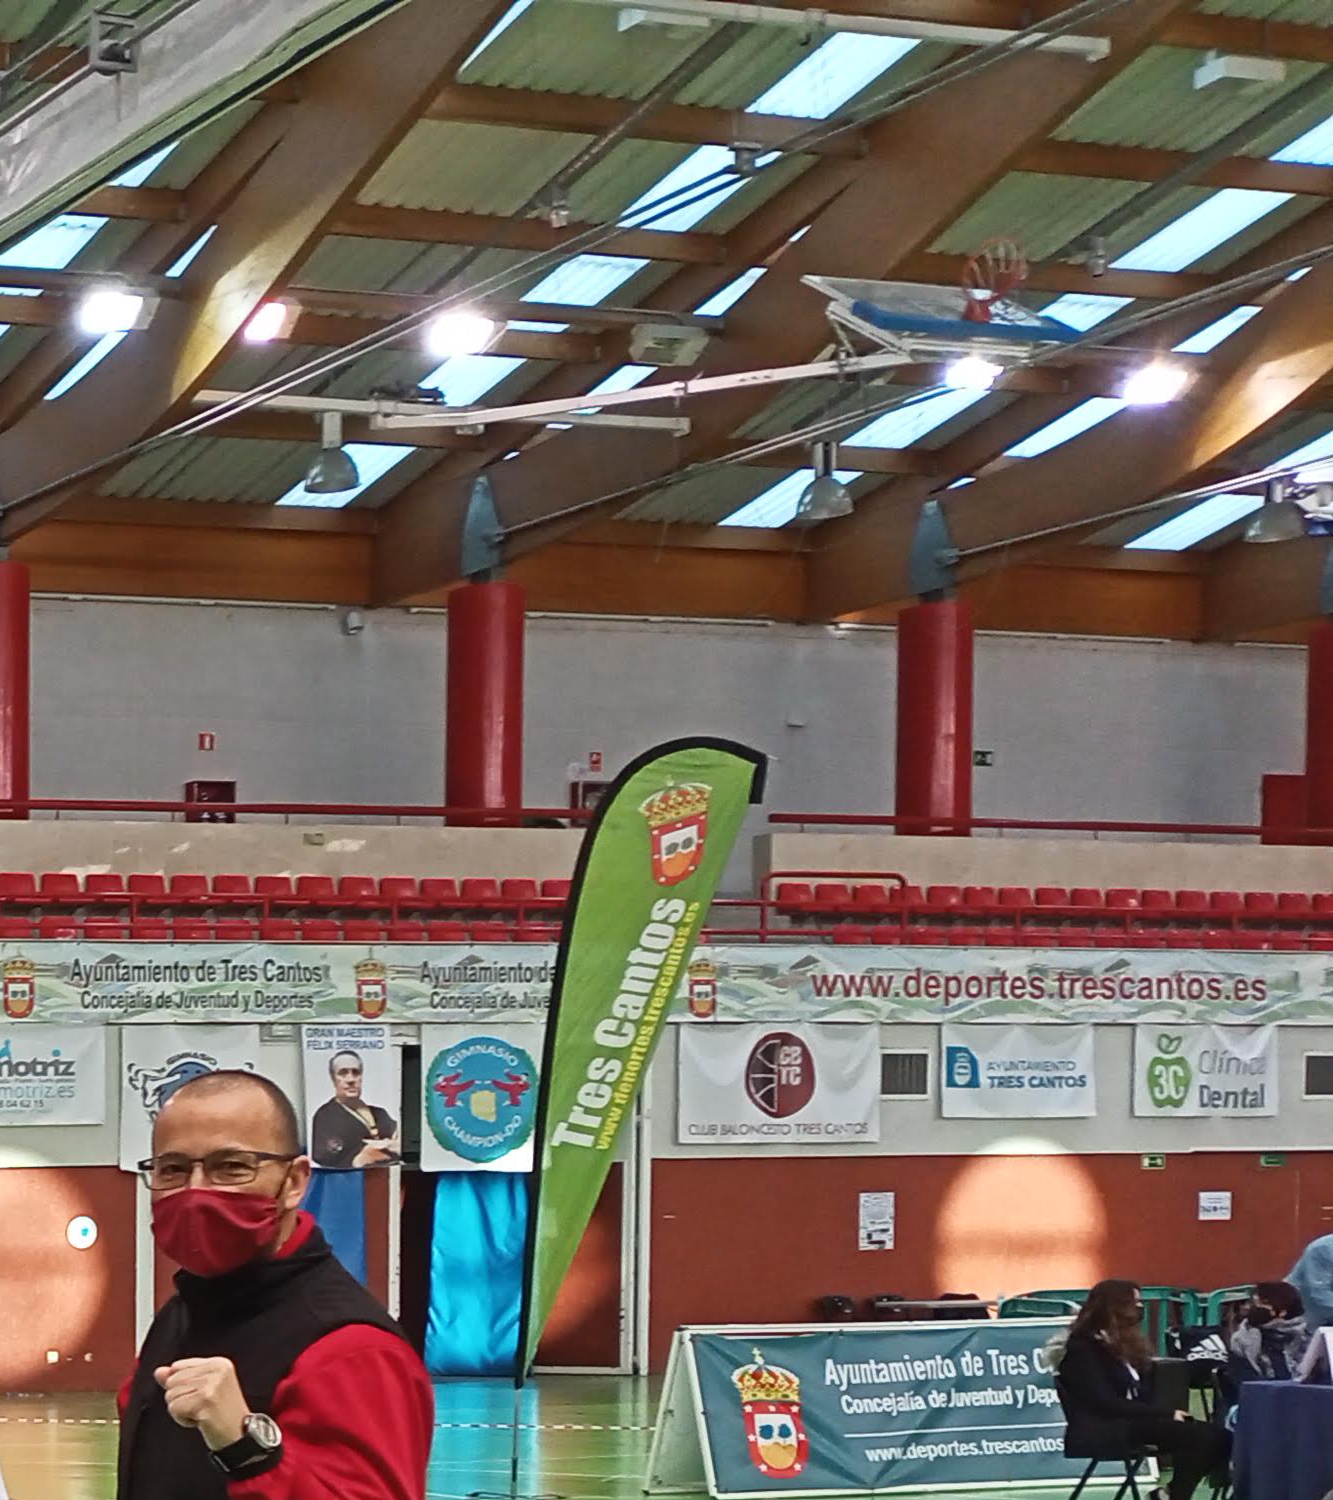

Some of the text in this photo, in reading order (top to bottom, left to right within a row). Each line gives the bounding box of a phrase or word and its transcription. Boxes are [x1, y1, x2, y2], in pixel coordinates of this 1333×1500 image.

[70, 958, 323, 988] Ayuntamiento de Tres Cantos
[419, 962, 532, 988] Ayuntamiento
[812, 967, 1267, 1007] www.deportes.trescantos.es
[155, 991, 173, 1009] de
[174, 990, 239, 1010] Juventud
[242, 996, 251, 1013] y
[253, 989, 314, 1011] Deportes
[500, 991, 516, 1009] de
[518, 990, 550, 1010] Juve
[306, 1027, 384, 1038] GRAN MAESTRO
[551, 898, 686, 1148] Tres Cantos
[336, 1039, 384, 1050] SERRANO
[446, 1044, 518, 1067] GIMNASIO
[987, 1060, 1076, 1072] AYUNTAMIENTO
[1198, 1049, 1267, 1076] Clínica
[779, 1066, 803, 1085] TC
[987, 1074, 1087, 1089] TRES CANTOS
[1153, 1064, 1184, 1101] 3C
[1198, 1084, 1265, 1109] Dental
[444, 1115, 521, 1148] CHAMPION-DO
[688, 1123, 717, 1136] CLUB
[795, 1122, 823, 1135] TRES
[825, 1122, 869, 1135] CANTOS
[824, 1355, 957, 1391] Ayuntamiento
[960, 1351, 984, 1378] de
[987, 1349, 1029, 1377] Tres
[841, 1390, 927, 1417] Concejalía
[928, 1390, 948, 1409] de
[948, 1385, 1013, 1408] Juventud
[1016, 1389, 1025, 1409] y
[865, 1436, 1066, 1463] www.deportes.trescantos
